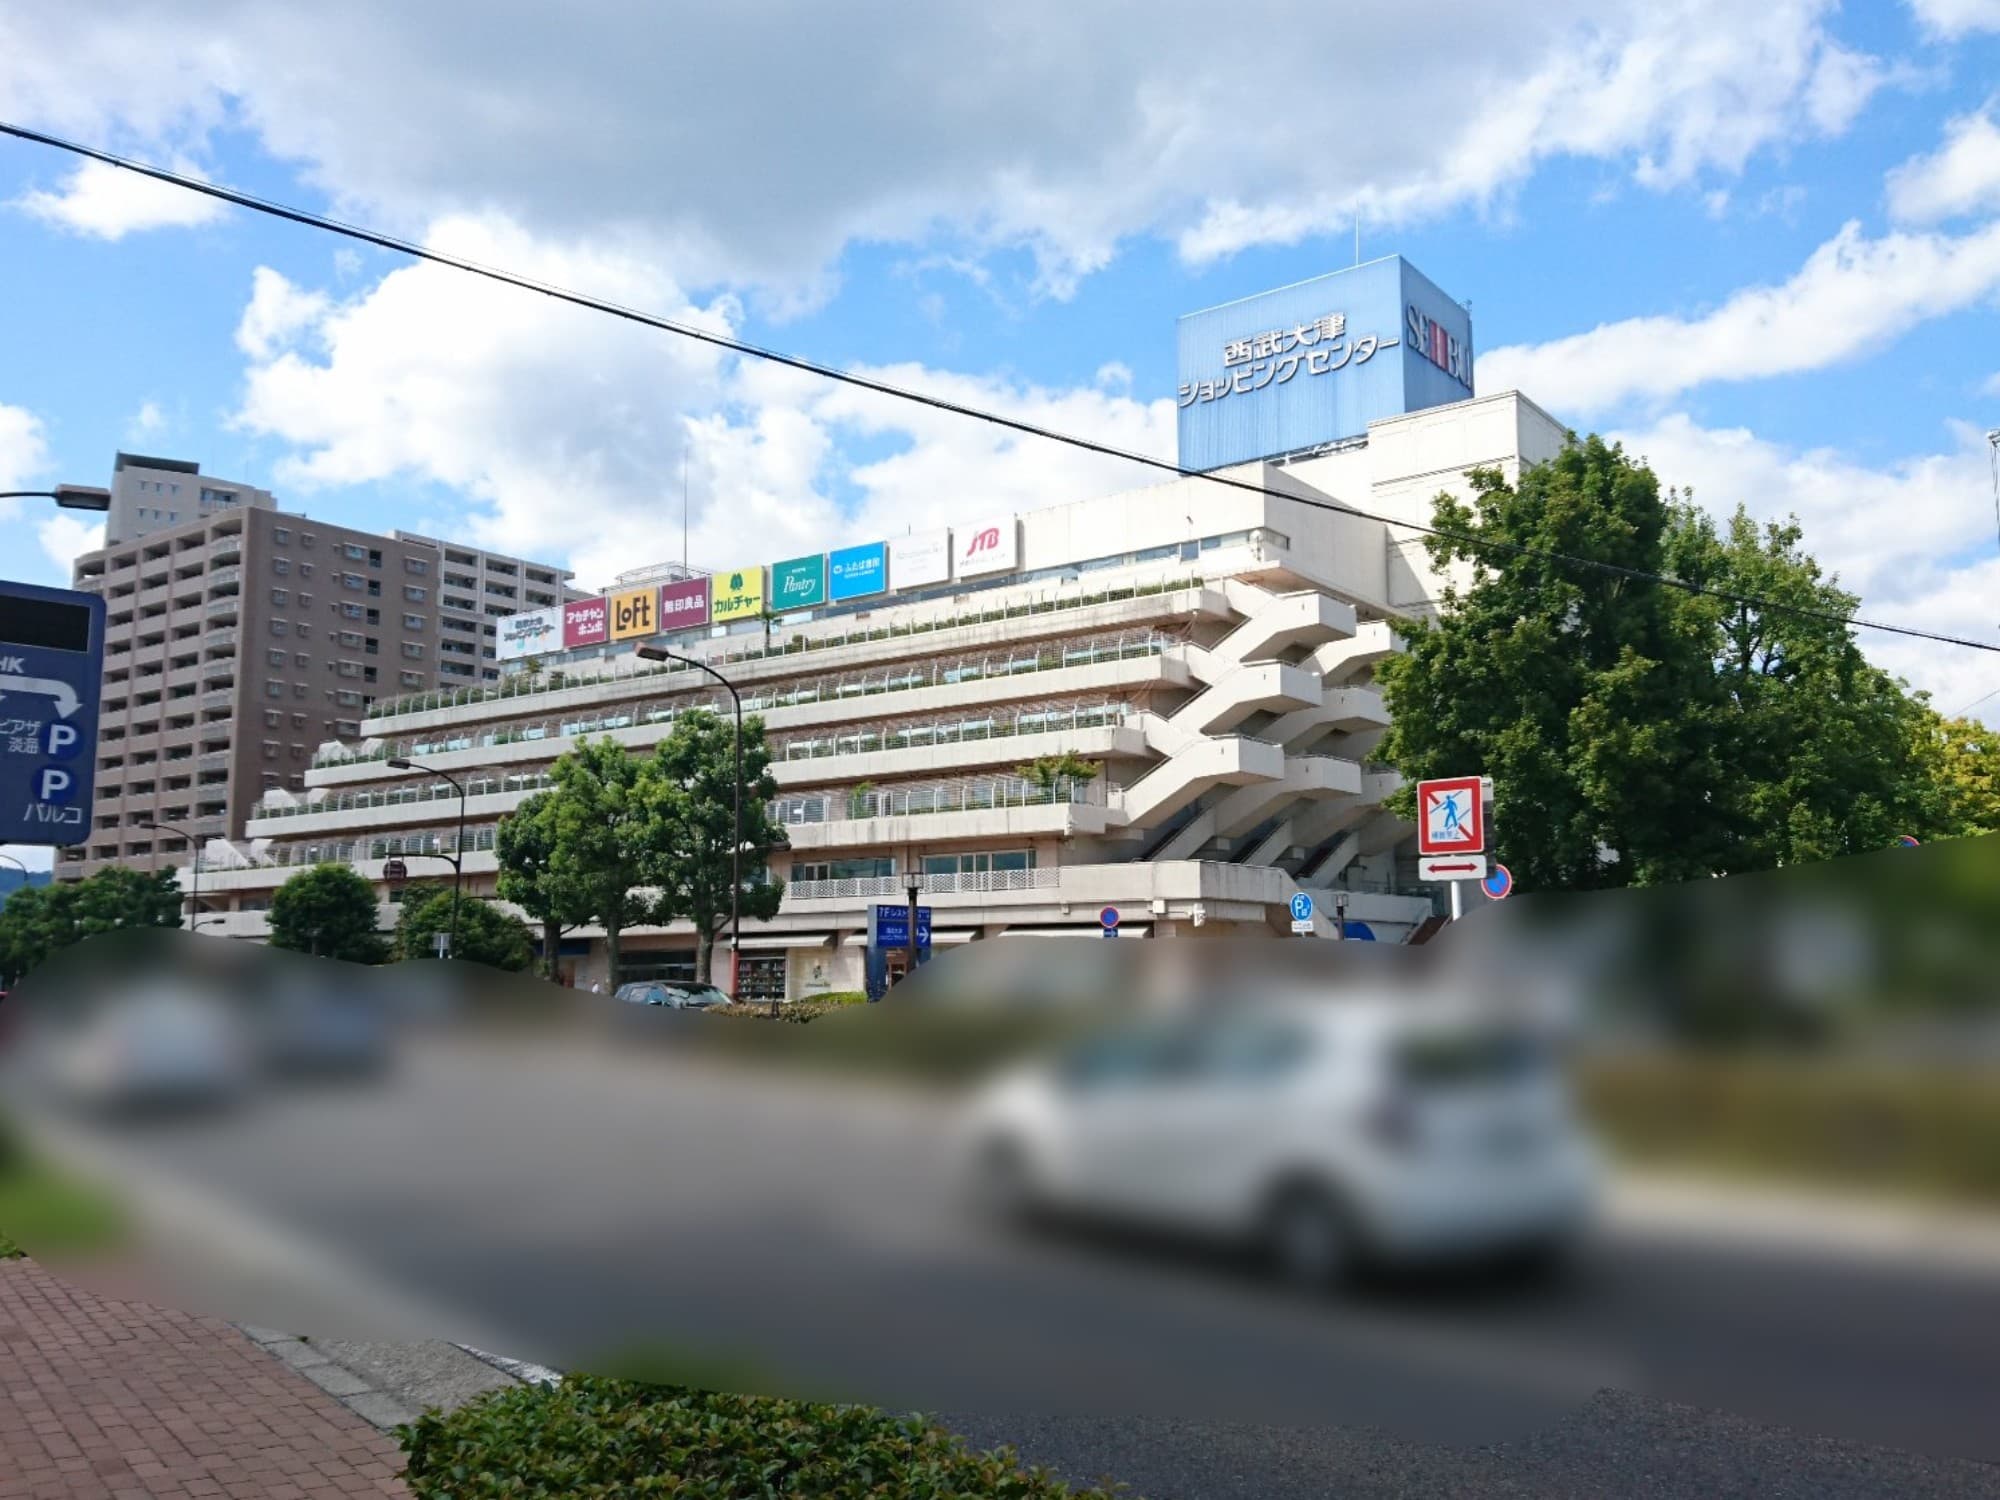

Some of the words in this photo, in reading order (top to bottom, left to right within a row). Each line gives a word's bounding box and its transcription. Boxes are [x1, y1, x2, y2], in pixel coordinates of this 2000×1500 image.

[1224, 312, 1346, 368] 西武大津
[1179, 335, 1400, 408] ショッピングセンター
[967, 527, 1000, 557] JTB
[783, 575, 816, 597] Pantry
[566, 607, 604, 625] アカチャン
[664, 594, 705, 615] 無印良品
[713, 595, 761, 613] カルチャー
[48, 724, 76, 754] P
[41, 770, 69, 799] P
[24, 803, 81, 824] パルコ
